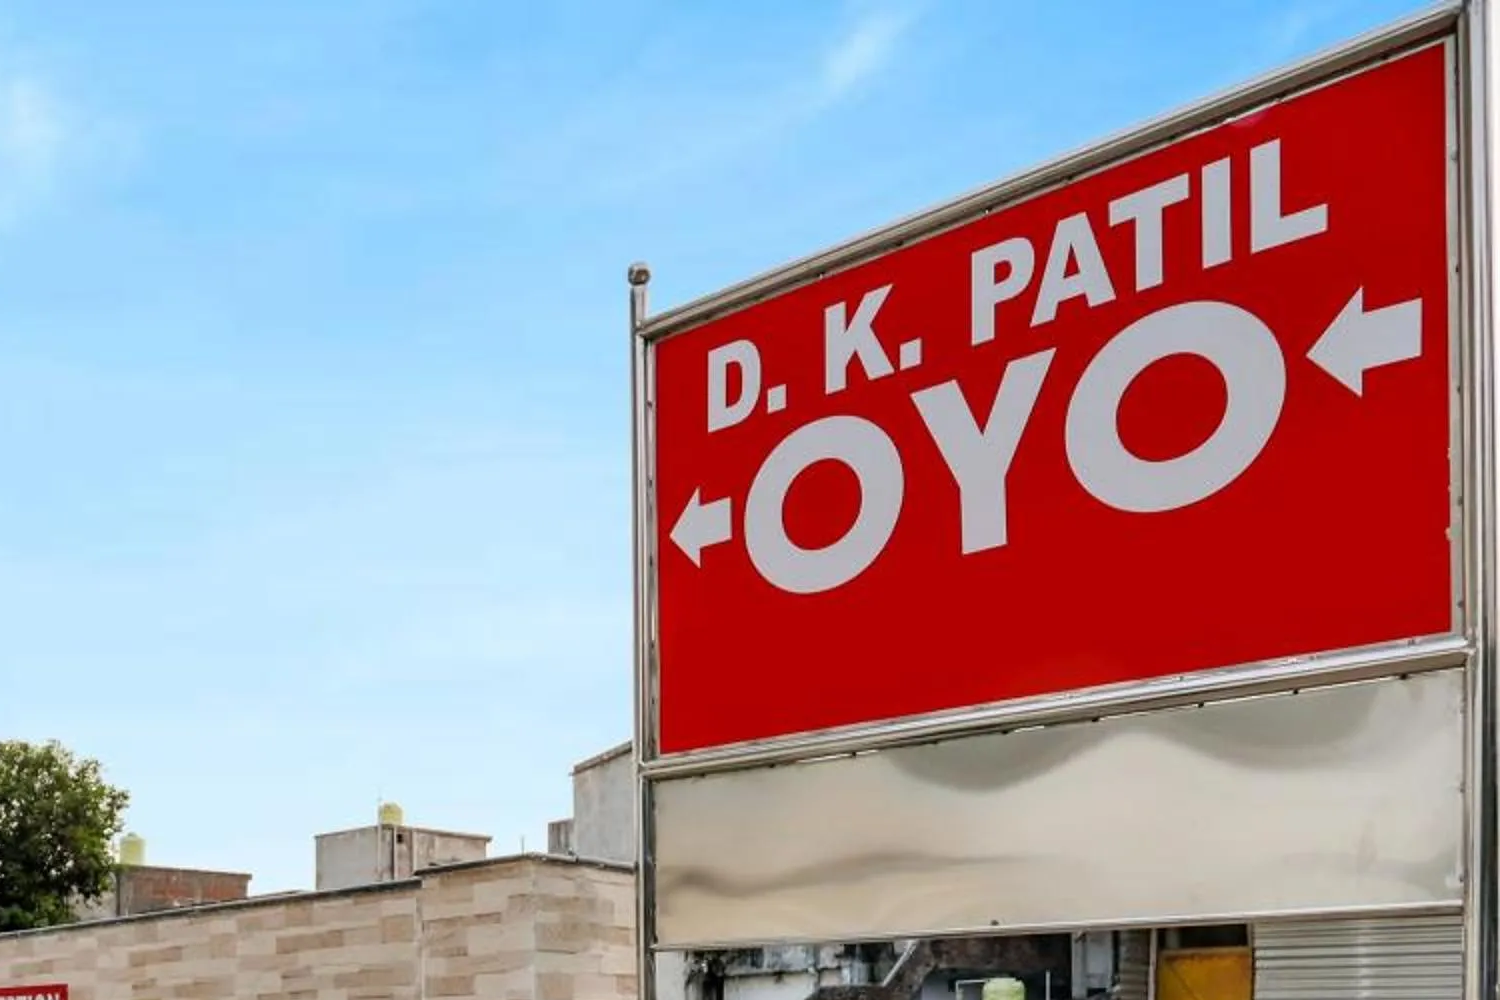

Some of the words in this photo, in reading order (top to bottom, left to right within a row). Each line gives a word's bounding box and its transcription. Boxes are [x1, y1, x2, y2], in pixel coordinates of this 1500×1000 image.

[708, 340, 787, 432] D.
[825, 284, 922, 394] K.
[971, 138, 1328, 346] PATIL
[744, 300, 1286, 594] OYO
